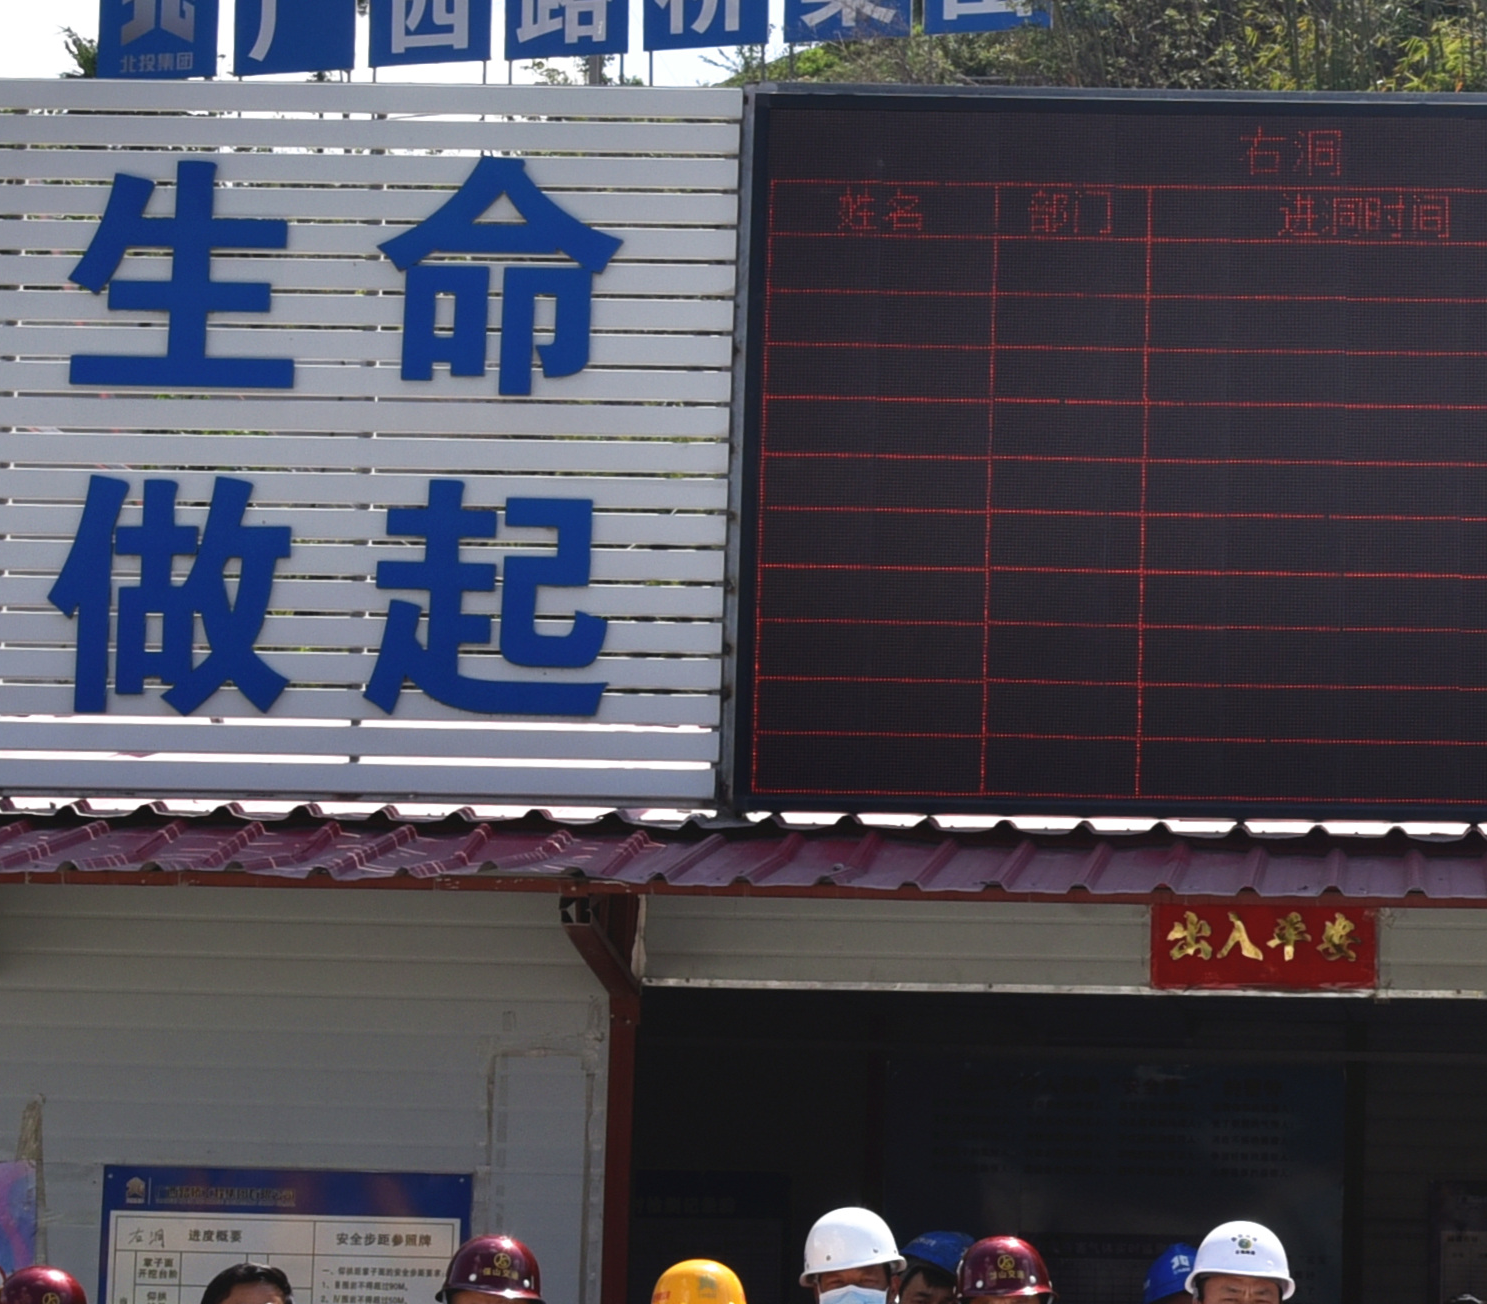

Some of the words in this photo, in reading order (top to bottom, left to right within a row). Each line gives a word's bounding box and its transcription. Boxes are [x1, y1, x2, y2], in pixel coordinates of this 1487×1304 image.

[119, 52, 194, 73] 北投集团
[1239, 125, 1345, 177] 右洞
[835, 187, 925, 235] 姓名
[1026, 190, 1114, 236] 部门
[1277, 192, 1453, 241] 进洞时间
[336, 1232, 432, 1248] 安全步距参照牌
